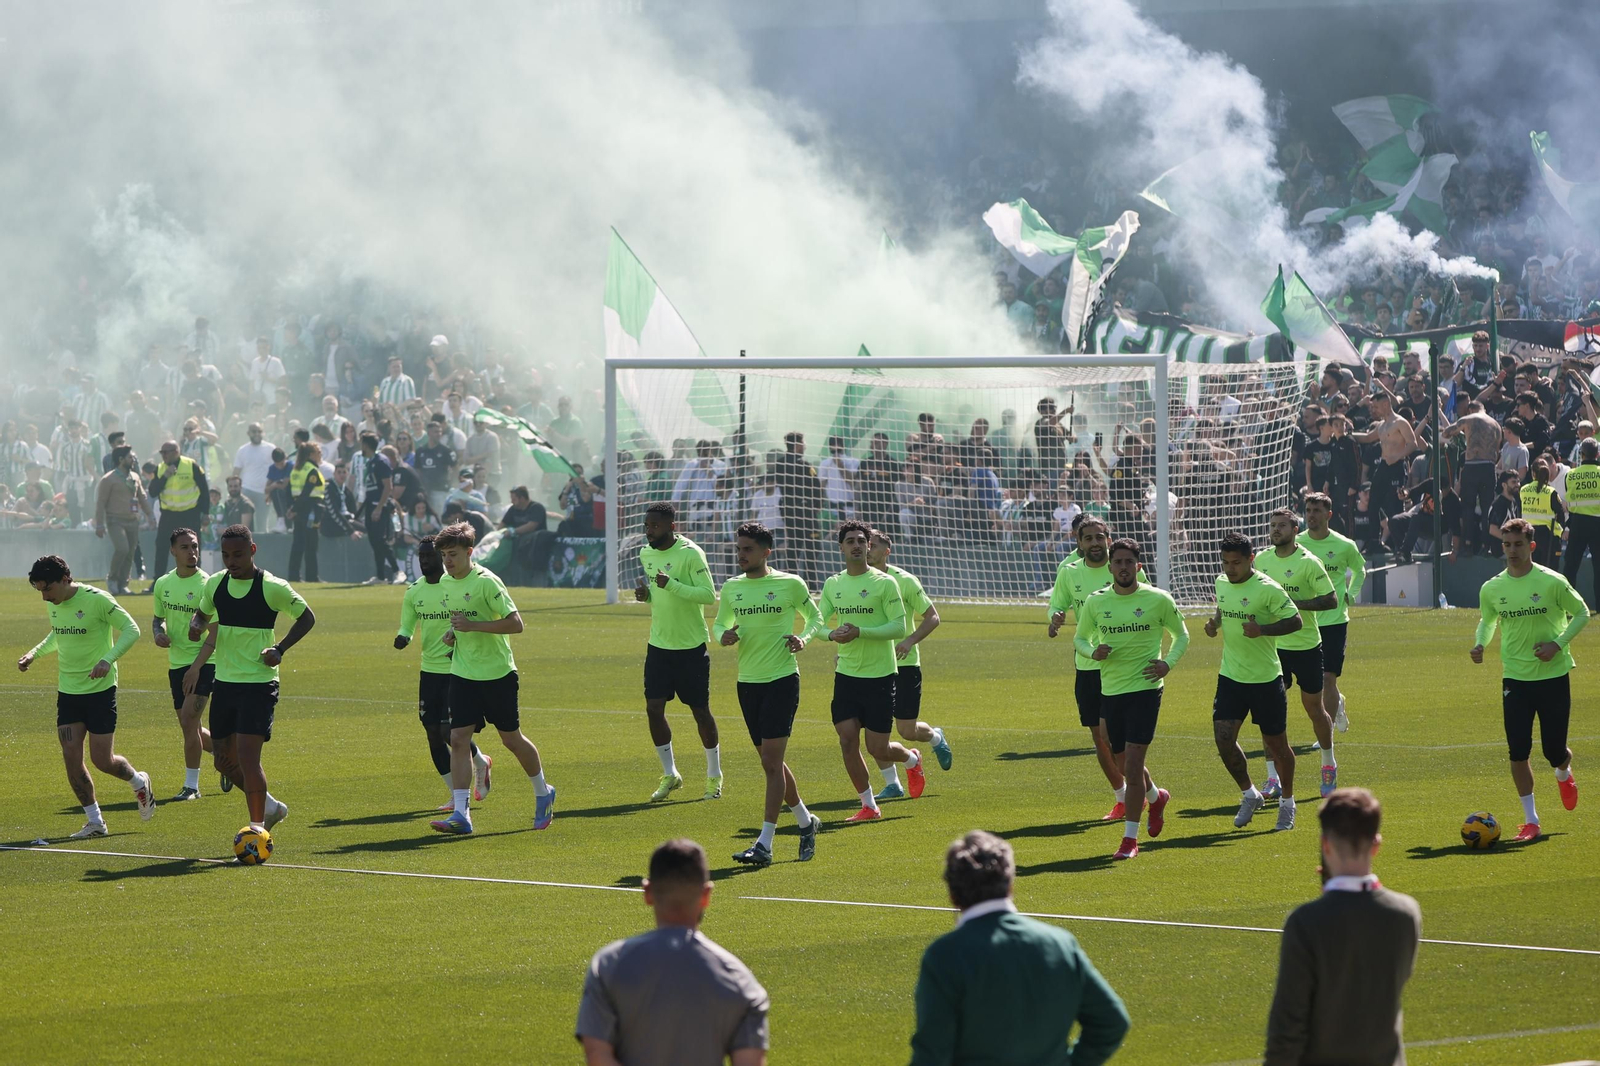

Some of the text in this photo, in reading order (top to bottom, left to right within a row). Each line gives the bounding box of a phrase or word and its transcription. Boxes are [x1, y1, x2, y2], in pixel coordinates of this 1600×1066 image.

[1568, 471, 1600, 481] SEGURIDA
[1575, 480, 1598, 490] 2500
[1523, 496, 1540, 505] 2571
[739, 604, 782, 616] trainline
[838, 605, 874, 614] trainline
[1509, 606, 1548, 618] trainline
[55, 625, 87, 635] trainline
[1108, 622, 1151, 634] trainline
